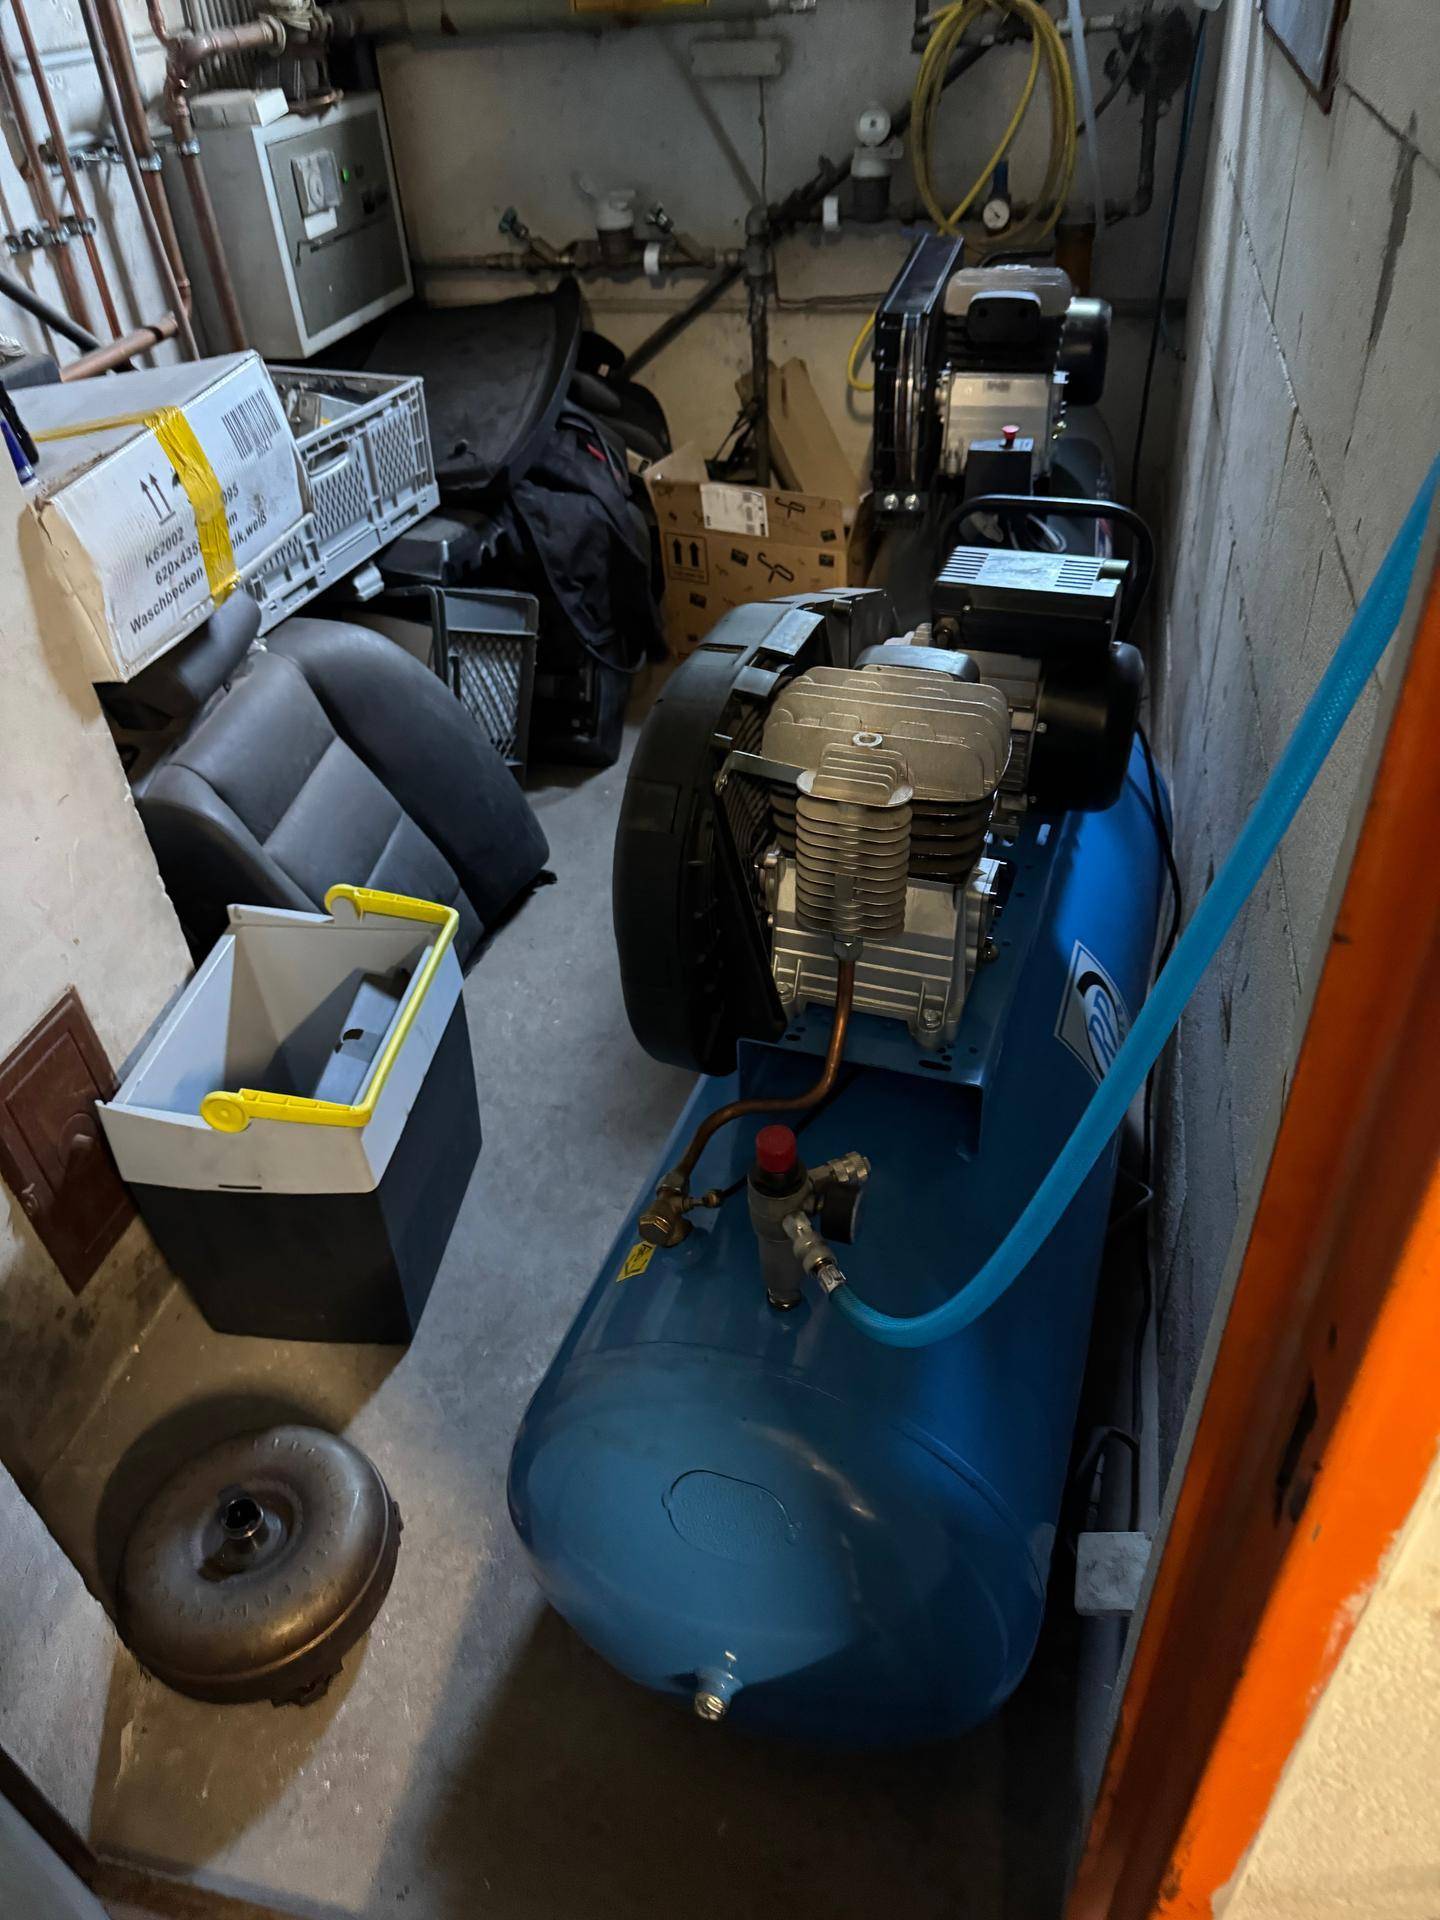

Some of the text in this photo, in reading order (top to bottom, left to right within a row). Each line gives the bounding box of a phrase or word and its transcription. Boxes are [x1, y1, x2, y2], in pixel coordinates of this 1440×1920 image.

[144, 526, 184, 569] K62002
[155, 540, 203, 586] 620x435
[130, 566, 204, 635] Waschbecken
